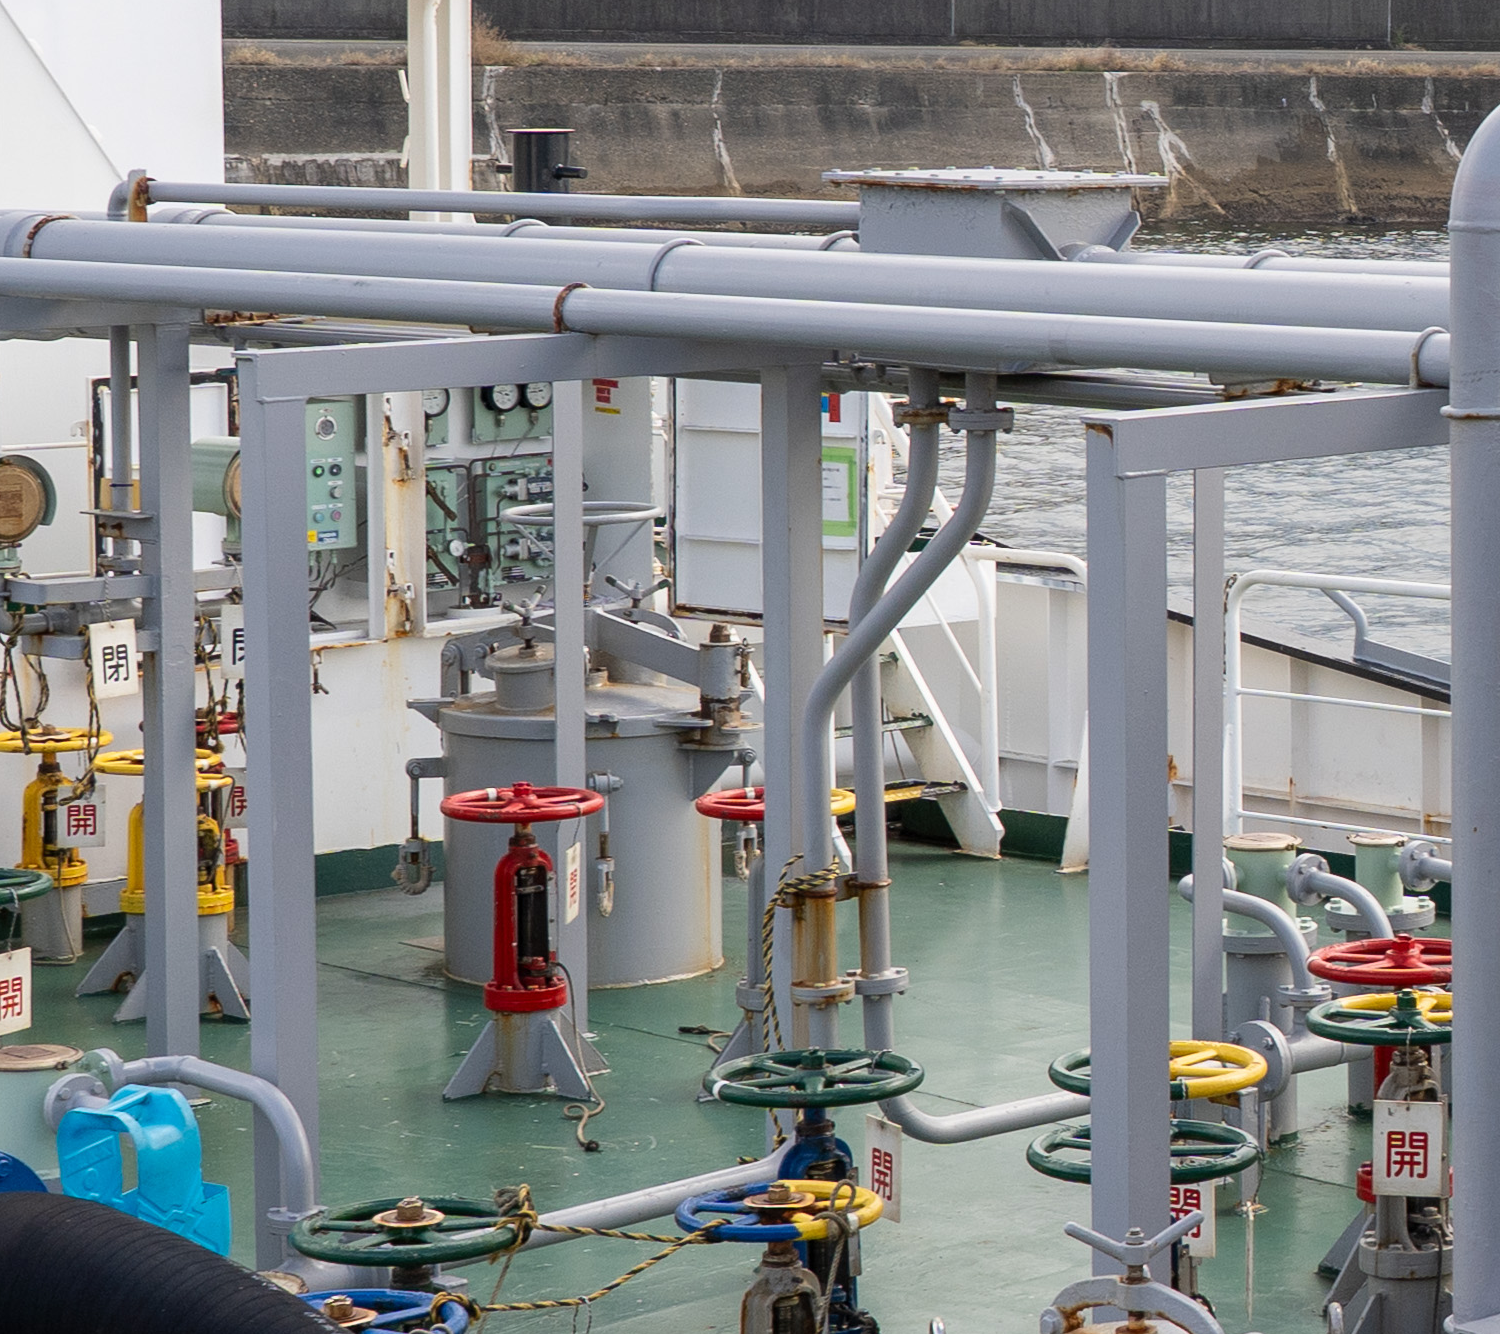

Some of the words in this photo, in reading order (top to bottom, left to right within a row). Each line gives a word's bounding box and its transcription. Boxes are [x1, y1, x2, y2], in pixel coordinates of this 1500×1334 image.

[102, 643, 129, 684] 閉
[66, 804, 97, 836] 開
[871, 1147, 893, 1201] 開
[1386, 1130, 1428, 1179] 開
